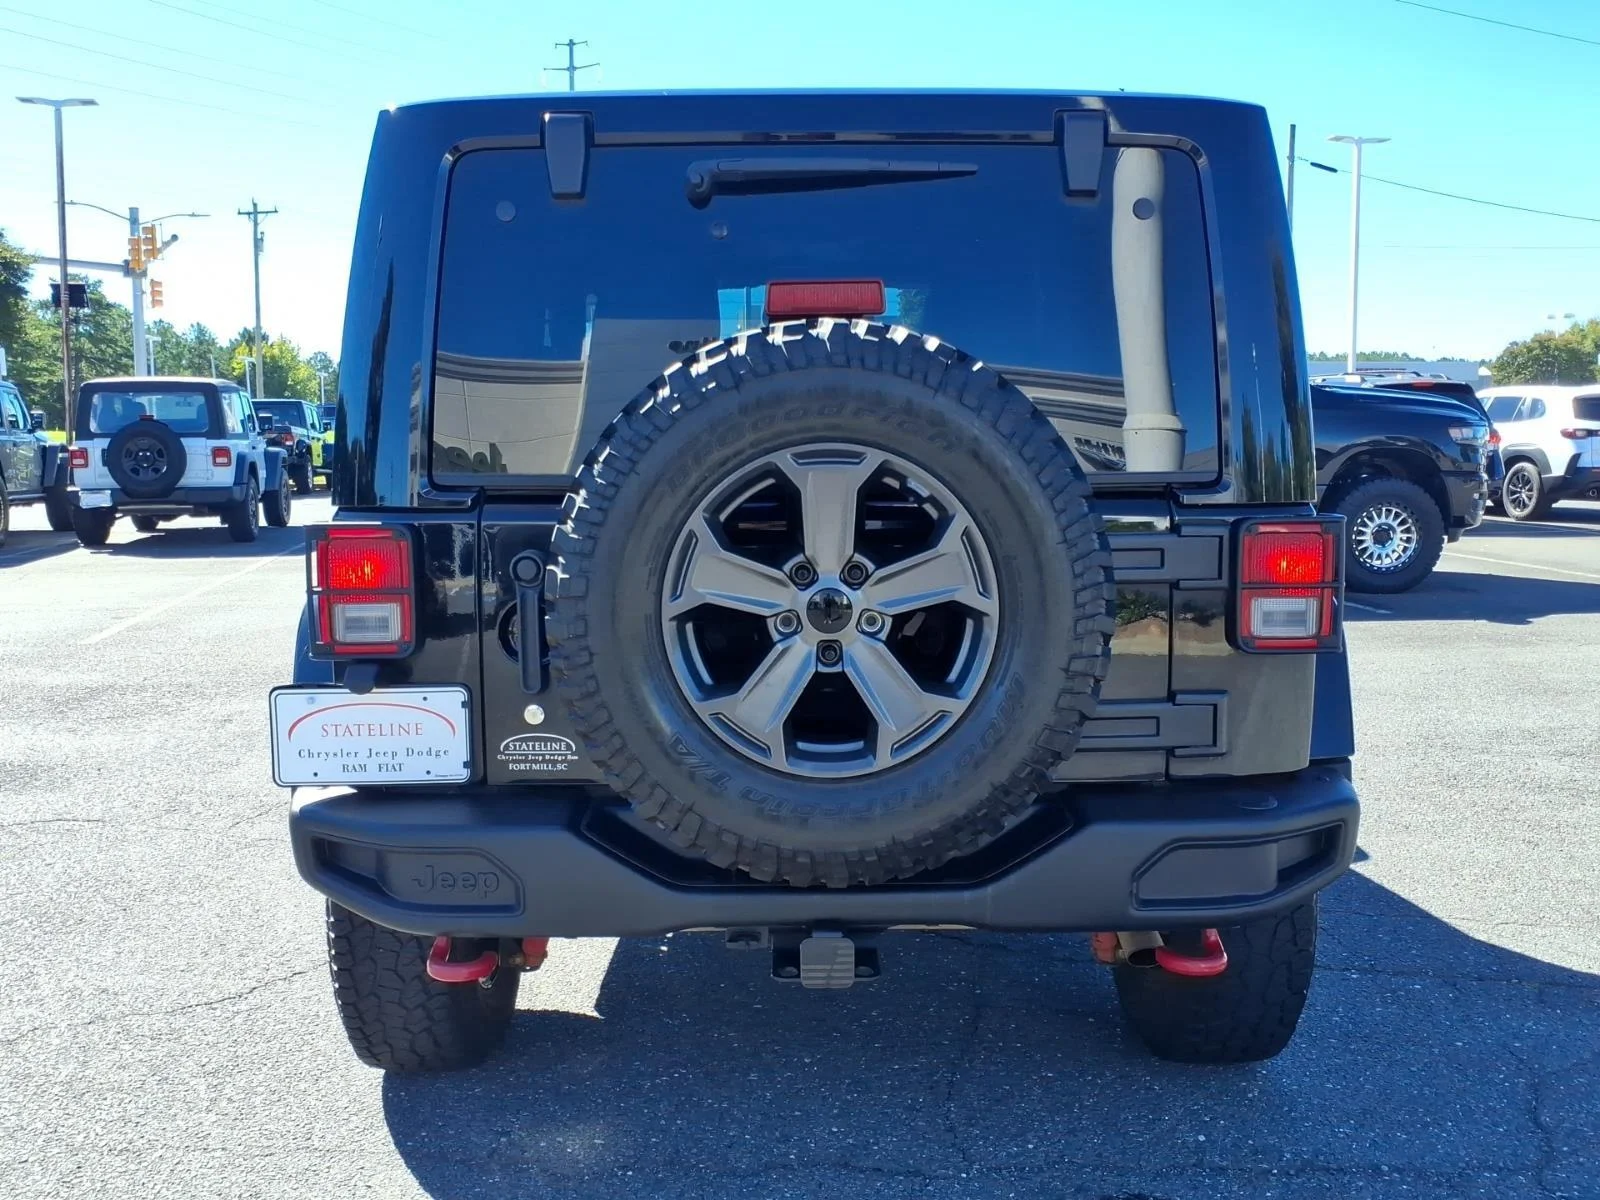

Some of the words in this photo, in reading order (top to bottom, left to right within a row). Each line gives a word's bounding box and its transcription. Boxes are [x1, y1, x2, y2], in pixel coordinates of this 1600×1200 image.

[321, 722, 423, 737] STATELINE
[508, 741, 567, 751] STATELINE
[298, 749, 360, 761] Chrysler
[366, 748, 399, 760] Jeep
[406, 747, 450, 759] Dodge
[342, 764, 368, 773] RAM
[378, 763, 405, 773] FIAT
[411, 864, 500, 899] Jeep
